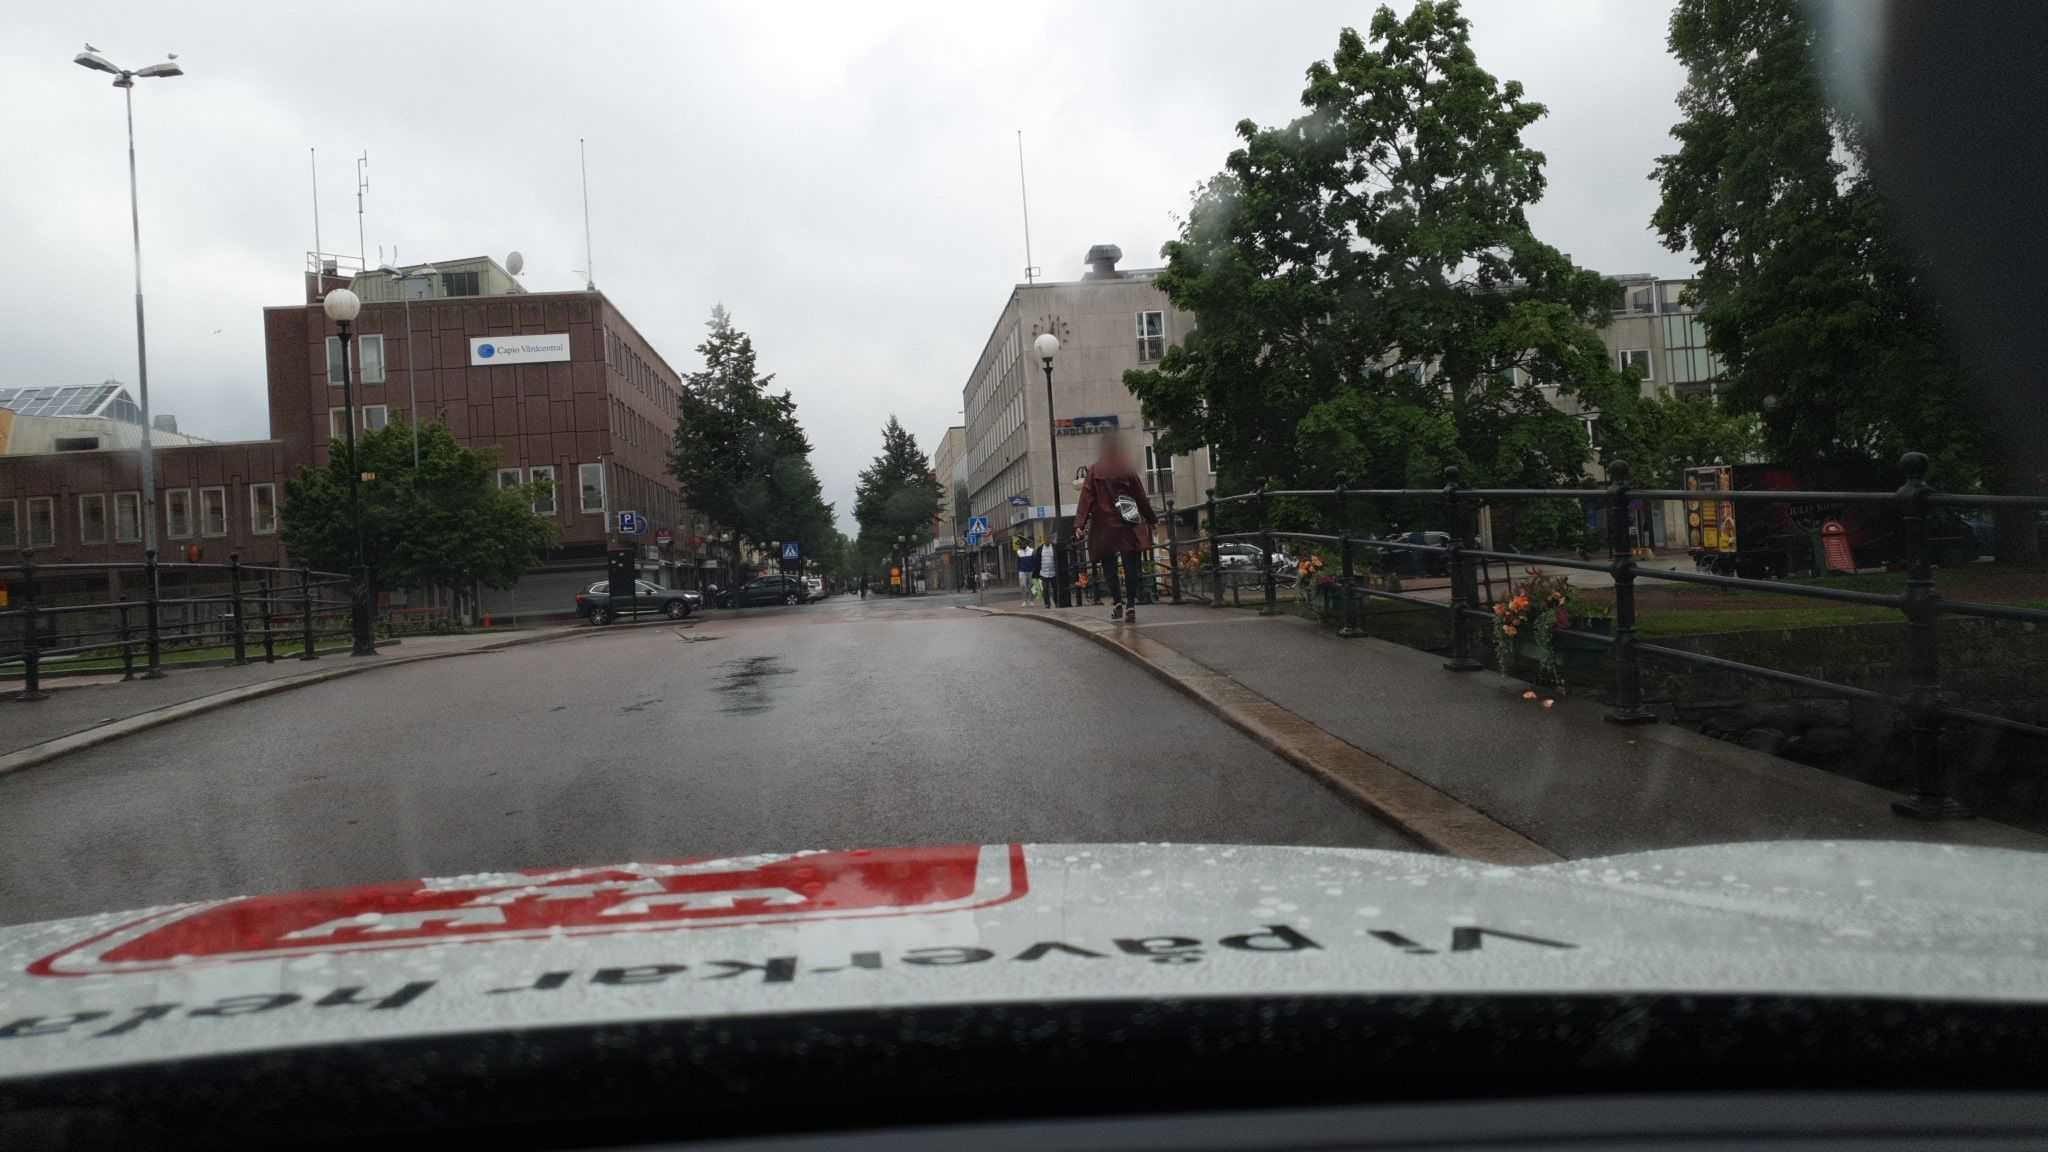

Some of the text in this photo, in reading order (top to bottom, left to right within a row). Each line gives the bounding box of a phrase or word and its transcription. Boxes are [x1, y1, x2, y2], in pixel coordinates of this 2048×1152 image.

[497, 346, 520, 356] Capio
[624, 514, 632, 524] P
[1367, 926, 1580, 957] Vi
[484, 924, 1324, 996] påverkar
